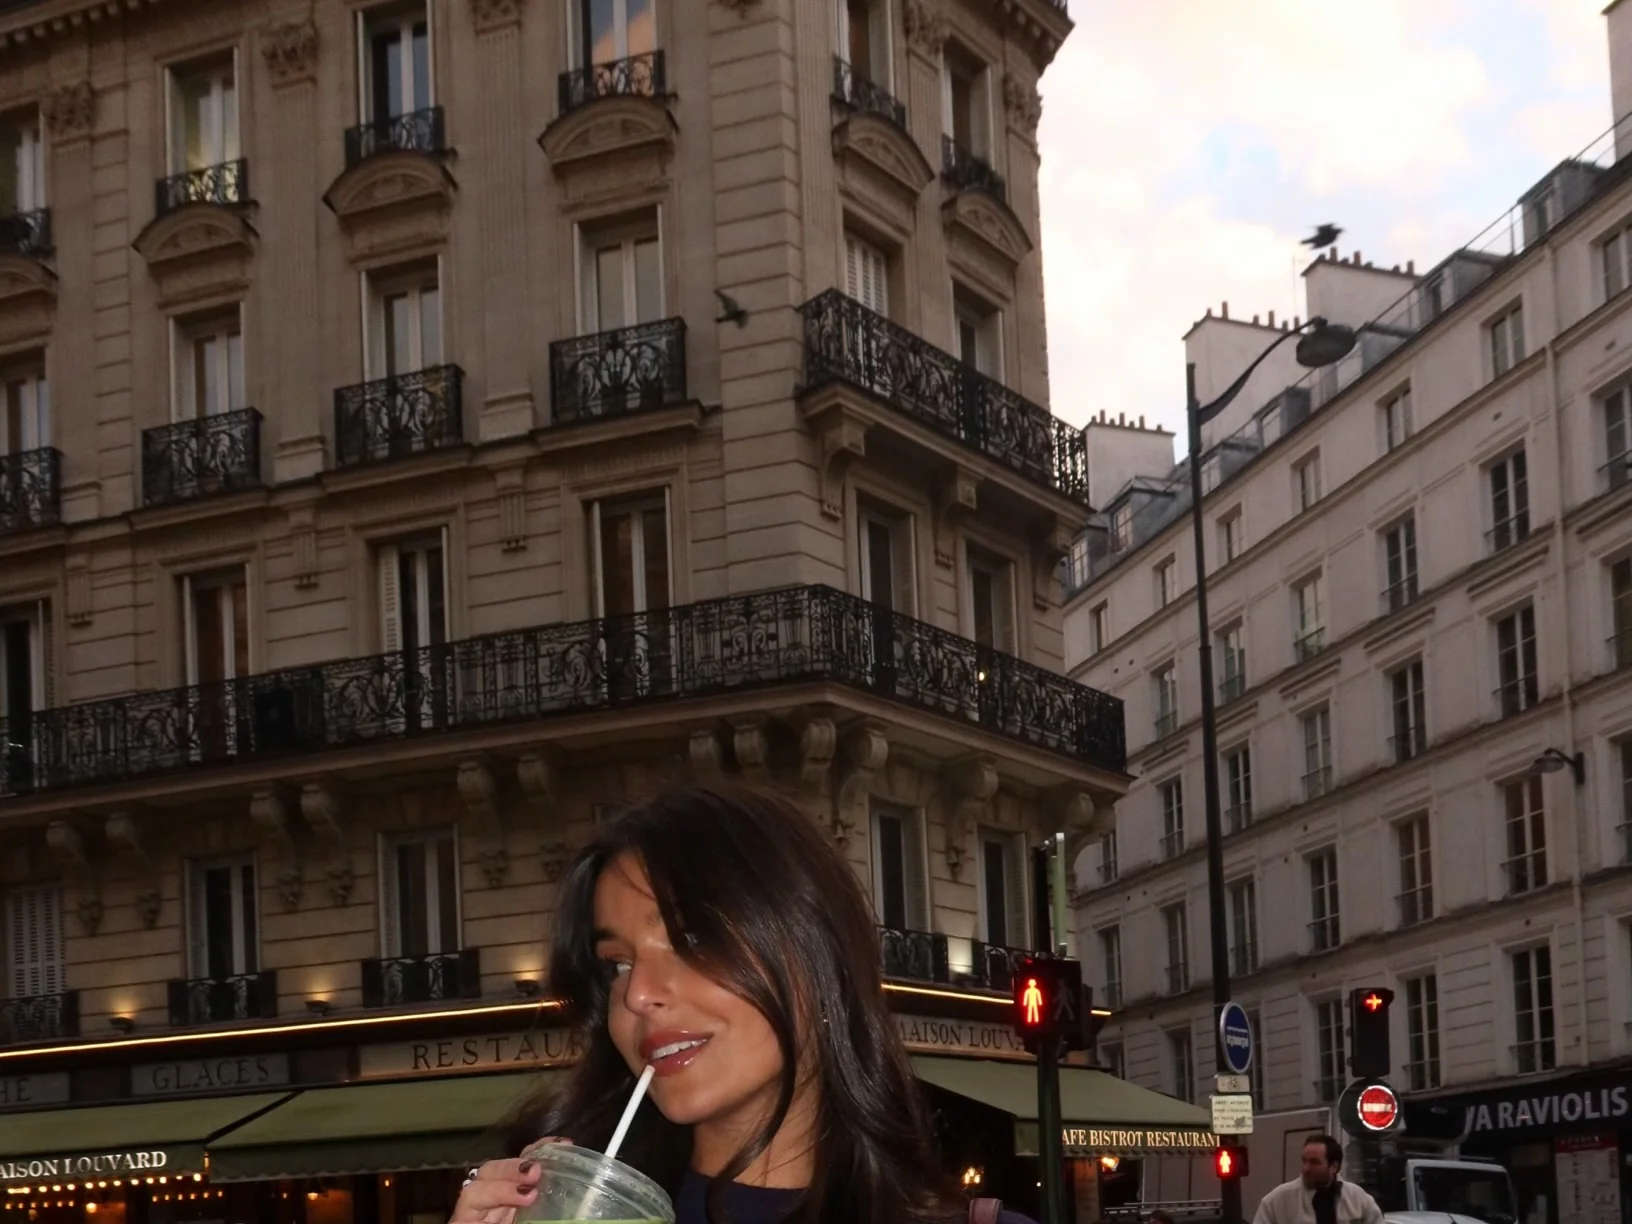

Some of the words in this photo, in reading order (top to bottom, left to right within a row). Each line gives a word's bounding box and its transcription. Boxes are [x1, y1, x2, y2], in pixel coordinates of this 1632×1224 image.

[152, 1058, 269, 1091] GLACES
[1498, 1086, 1628, 1129] RAVIOLIS
[1090, 1129, 1143, 1147] BISTROT
[64, 1151, 167, 1174] LOUVARD
